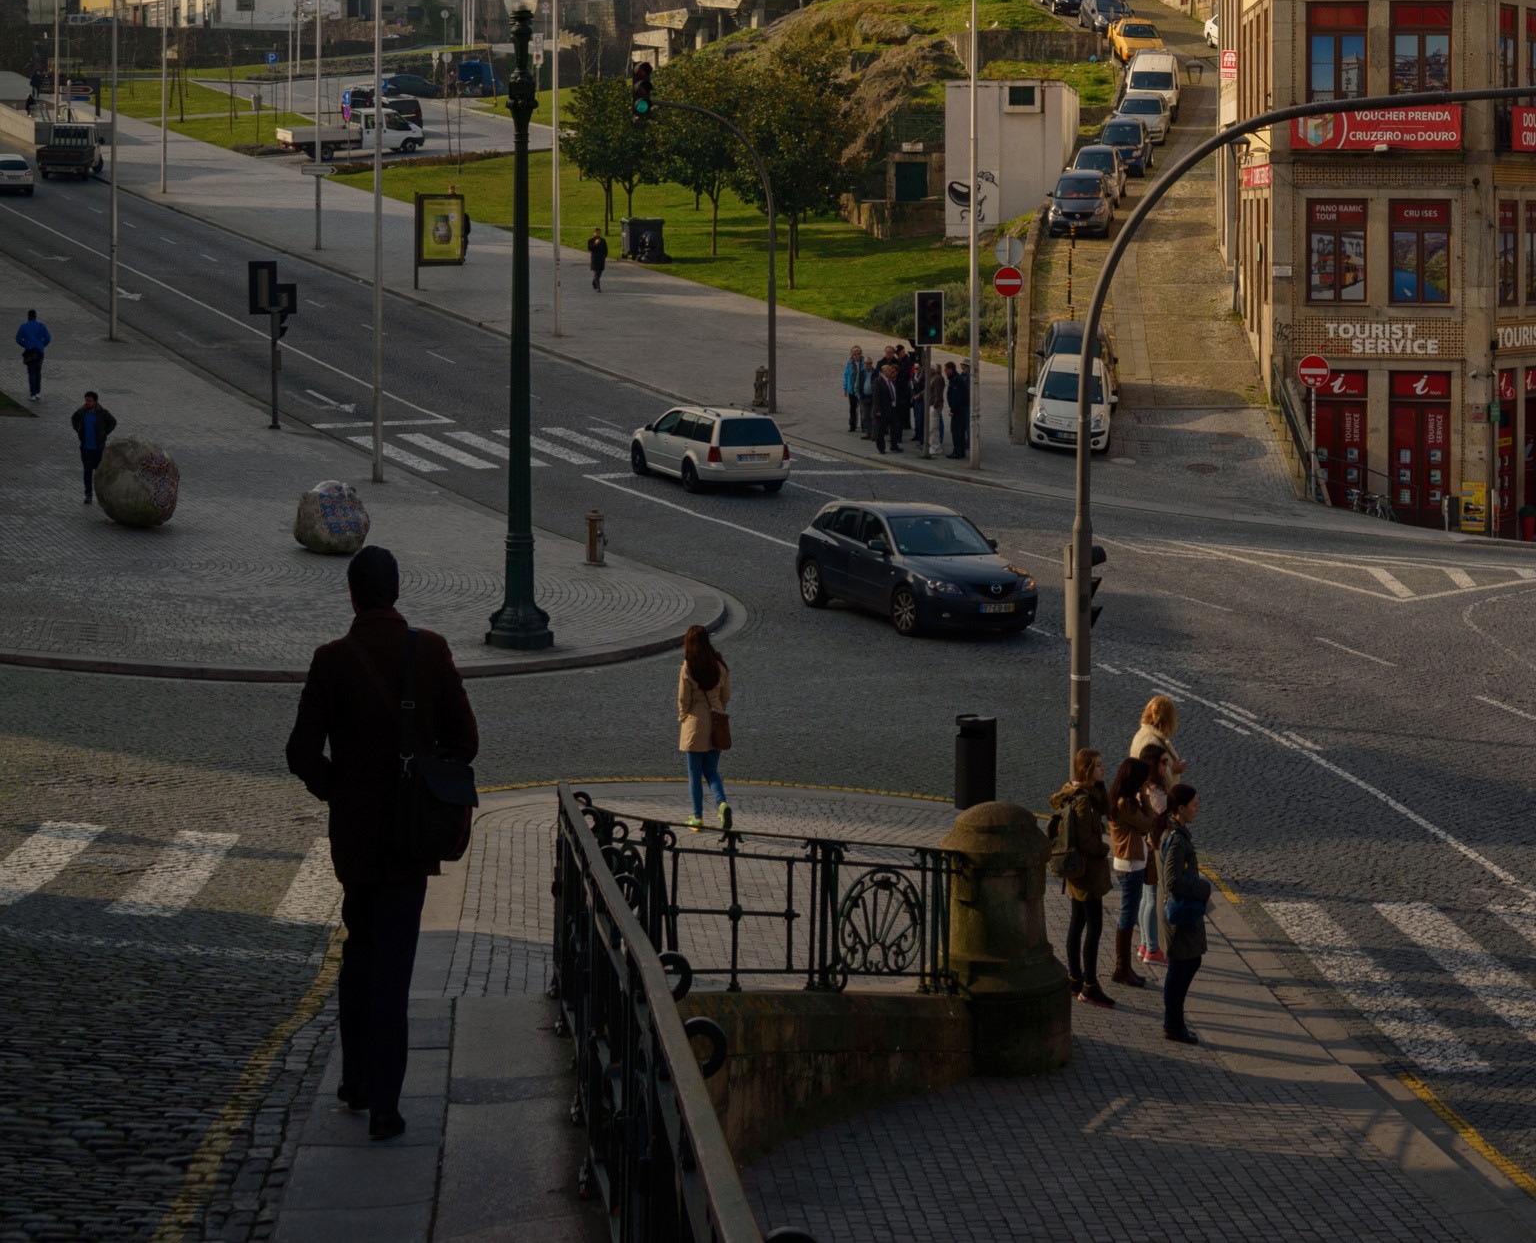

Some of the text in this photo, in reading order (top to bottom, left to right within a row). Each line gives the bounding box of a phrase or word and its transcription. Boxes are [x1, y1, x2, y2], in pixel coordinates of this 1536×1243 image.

[1355, 111, 1451, 121] VOUCHER PRENDA
[1349, 131, 1401, 142] CRUZEIRO
[1418, 131, 1457, 141] DOURO
[1315, 213, 1337, 221] TOUR
[1326, 323, 1416, 339] TOURIST
[1351, 339, 1439, 354] SERVICE
